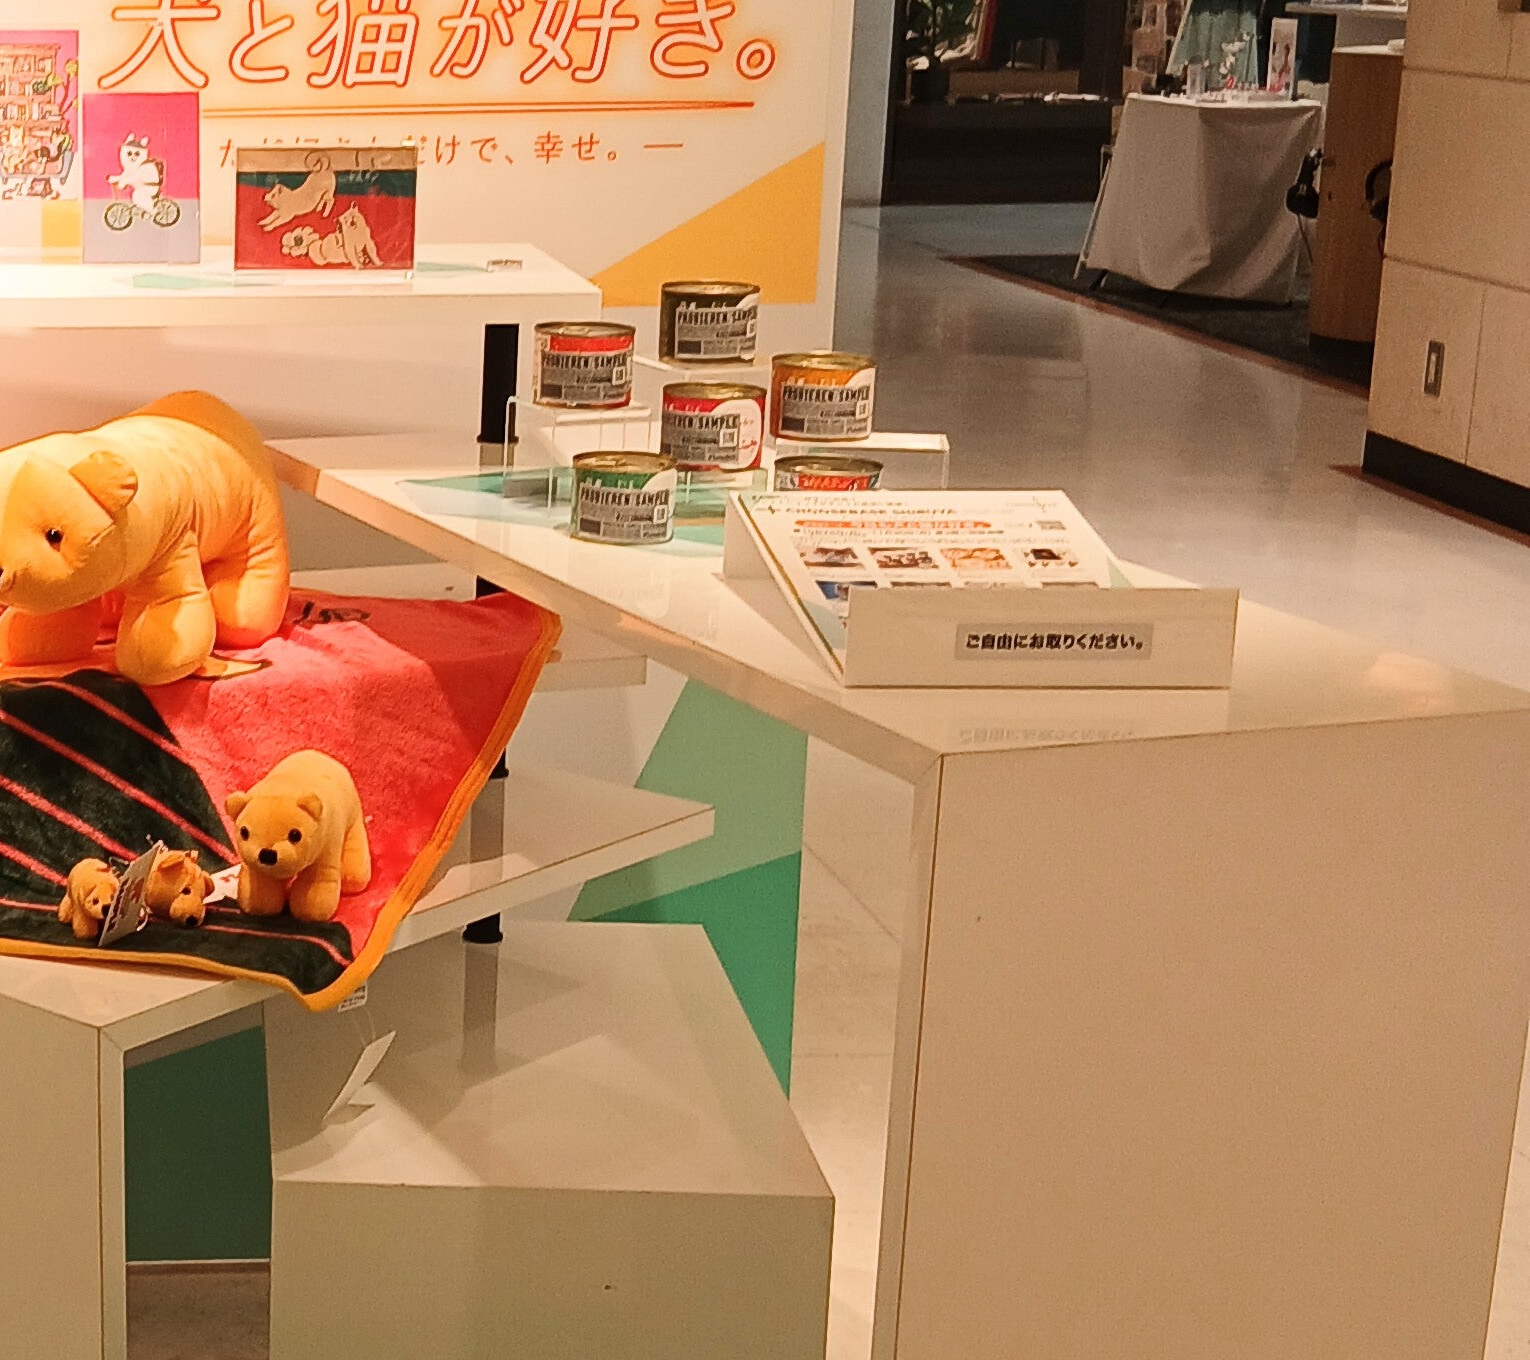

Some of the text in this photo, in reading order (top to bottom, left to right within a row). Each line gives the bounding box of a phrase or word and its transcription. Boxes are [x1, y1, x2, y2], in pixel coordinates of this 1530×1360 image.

[965, 633, 1143, 651] ご自由にお取りください。
